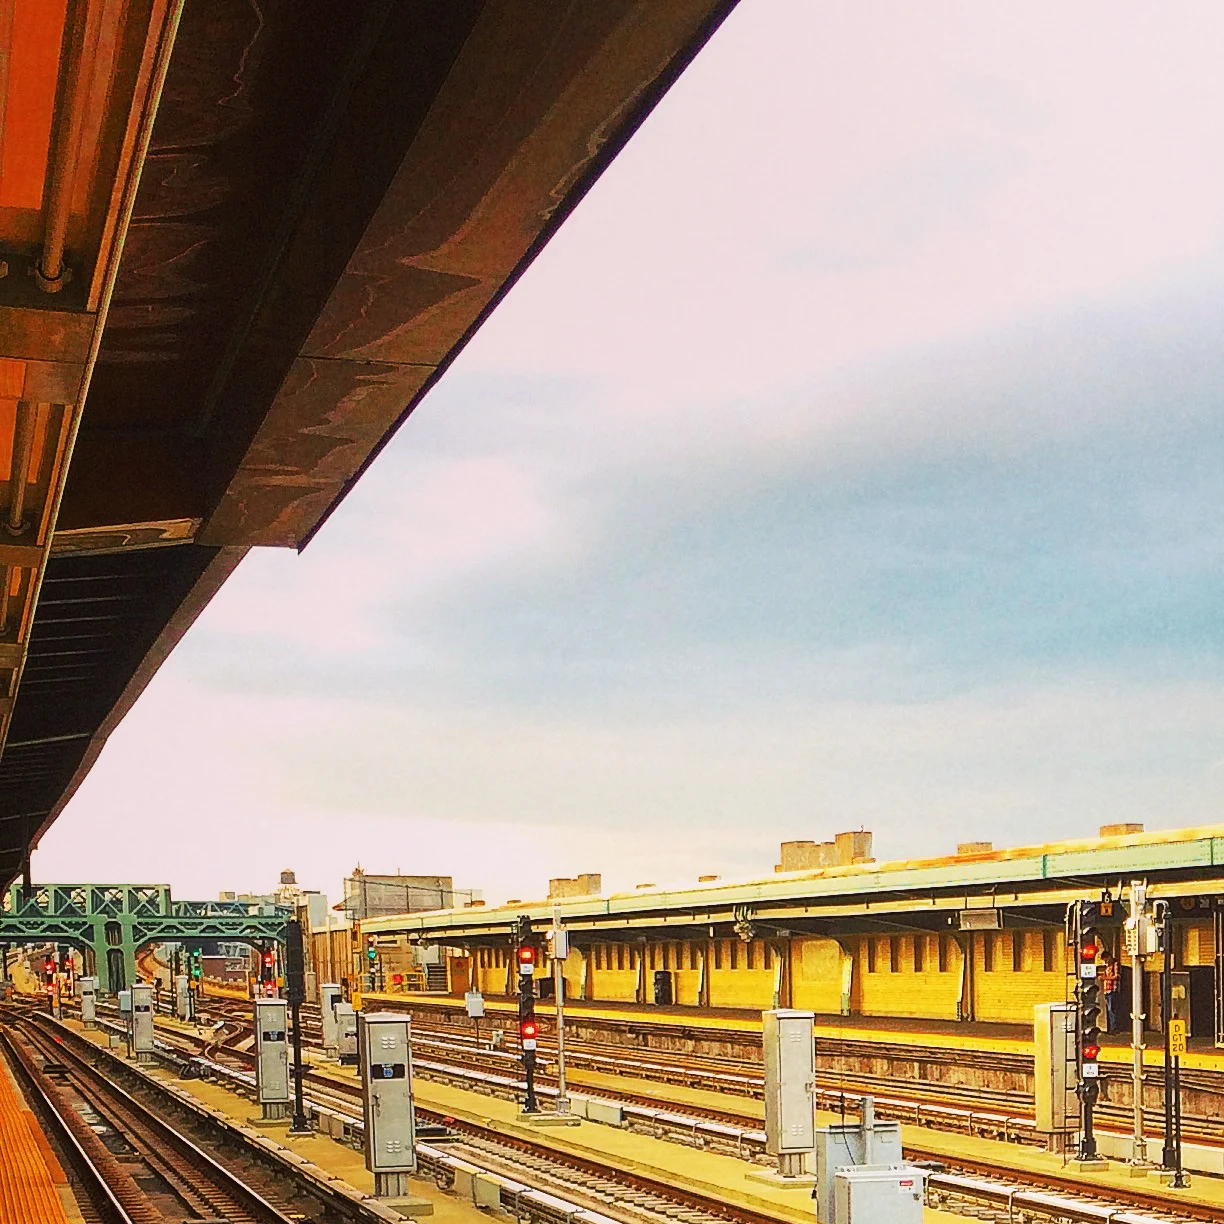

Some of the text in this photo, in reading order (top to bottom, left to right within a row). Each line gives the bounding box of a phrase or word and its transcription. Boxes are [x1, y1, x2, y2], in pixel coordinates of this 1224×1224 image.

[1104, 893, 1110, 904] 6
[1174, 1024, 1181, 1033] D
[1172, 1033, 1183, 1042] GT
[1172, 1043, 1184, 1052] 20
